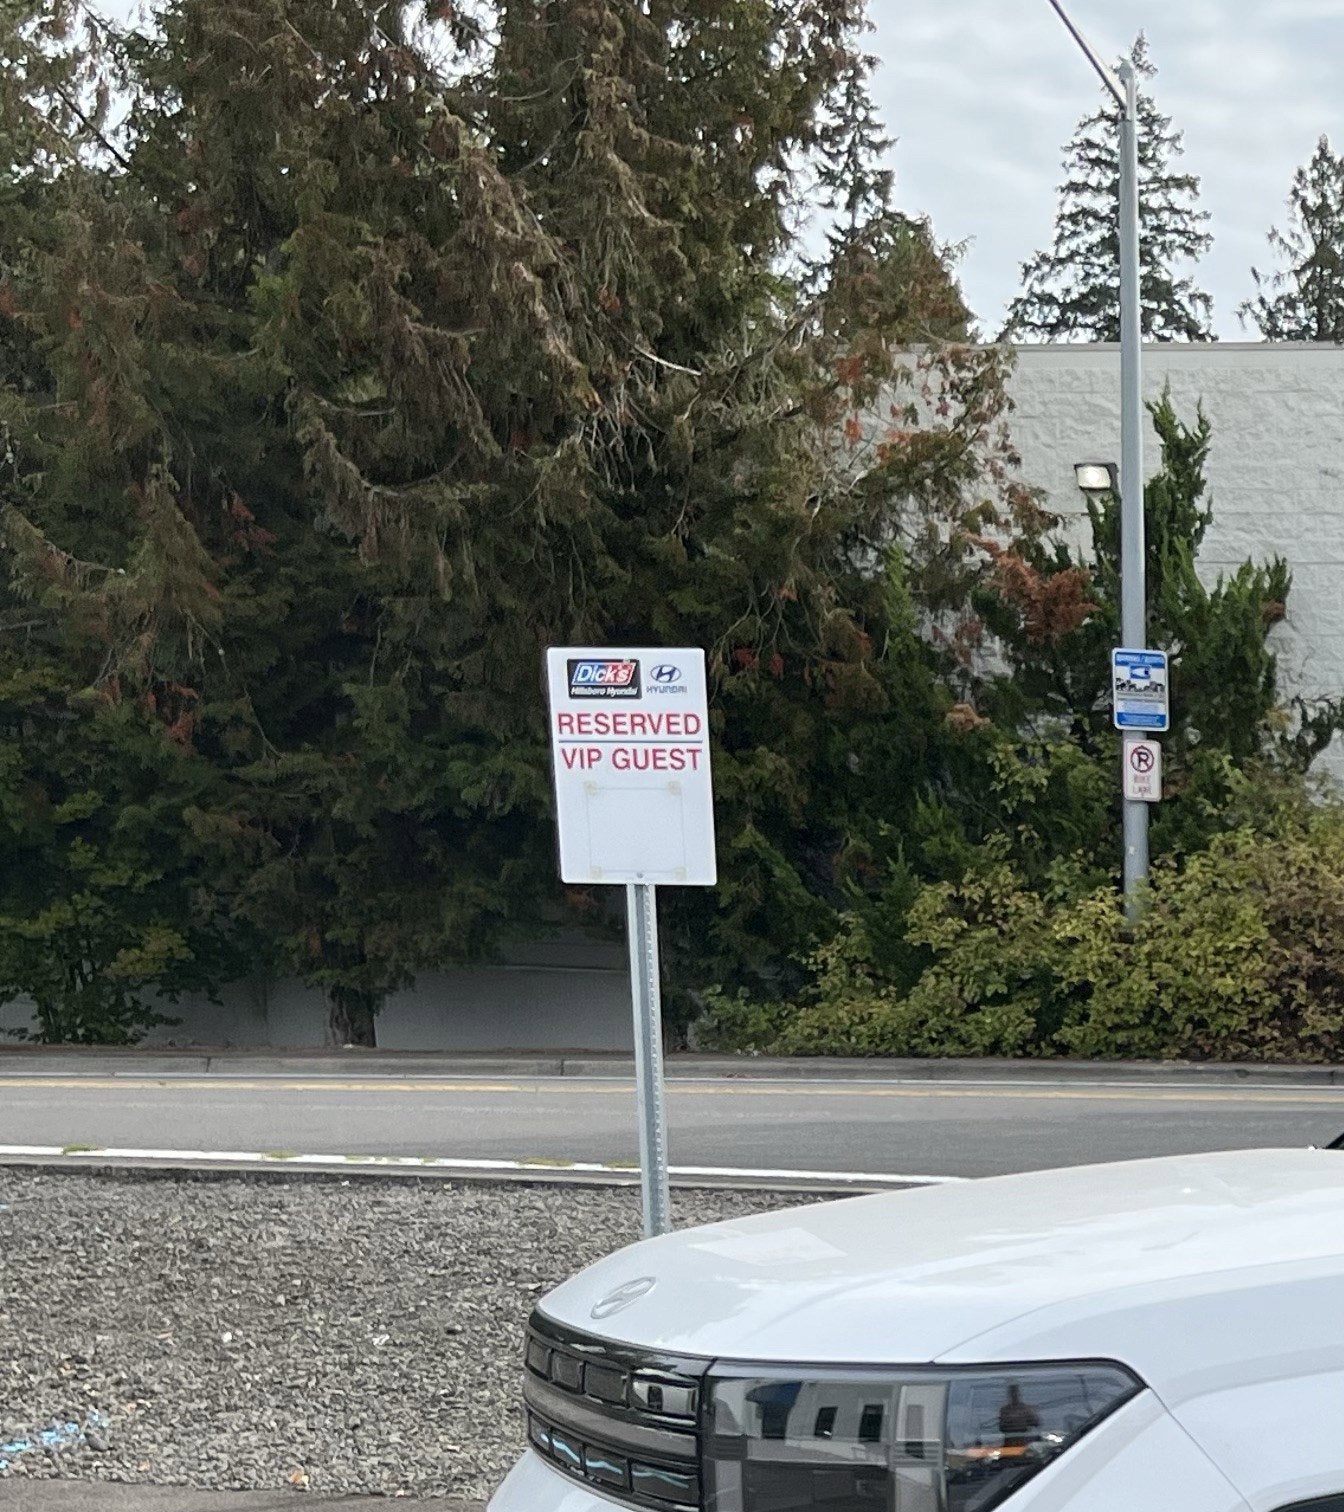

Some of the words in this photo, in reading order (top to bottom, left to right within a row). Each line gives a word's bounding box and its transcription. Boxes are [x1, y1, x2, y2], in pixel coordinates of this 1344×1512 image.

[557, 712, 701, 736] RESERVED
[561, 748, 603, 770] VIP
[611, 748, 703, 771] GUEST
